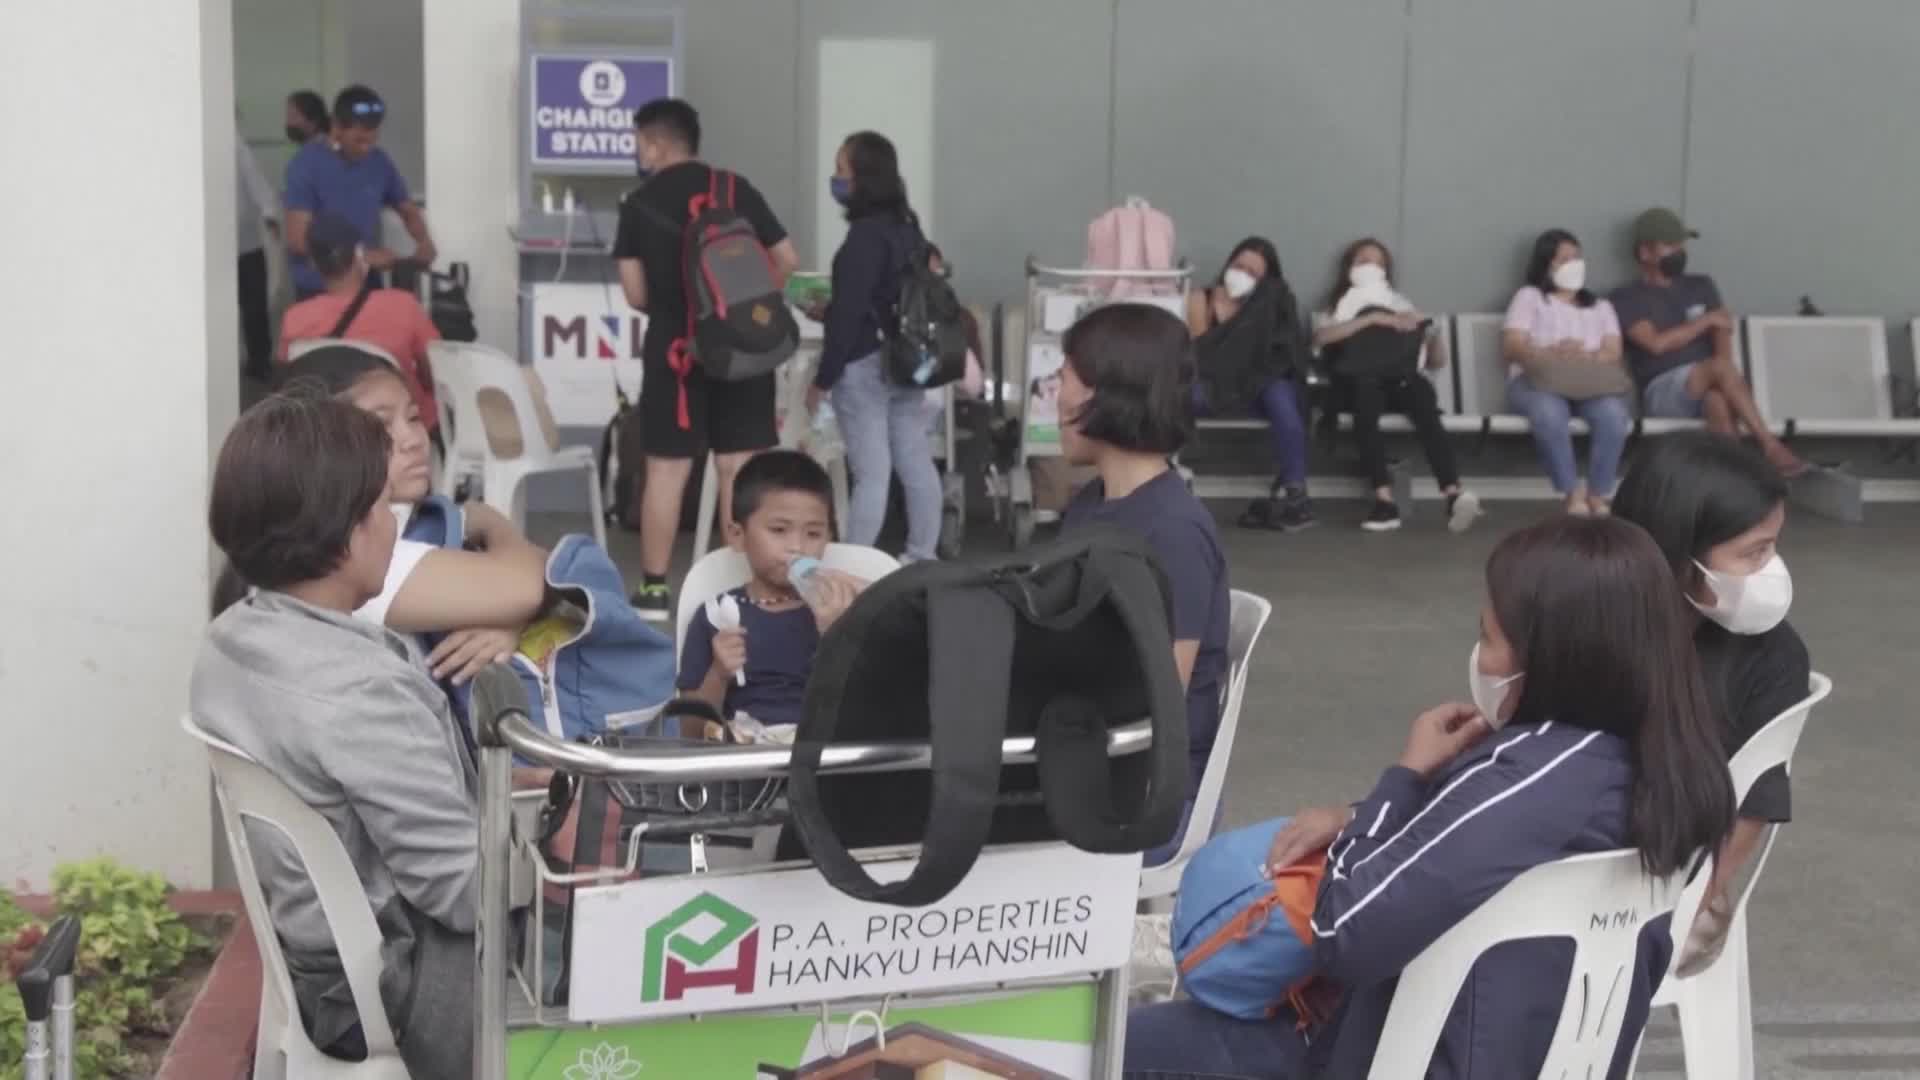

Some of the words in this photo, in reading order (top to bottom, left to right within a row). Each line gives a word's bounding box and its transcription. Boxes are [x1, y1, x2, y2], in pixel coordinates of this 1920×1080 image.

[537, 107, 635, 129] CHARGI
[552, 131, 638, 154] STATIO
[772, 920, 846, 952] P.A.
[866, 895, 1092, 944] PROPERTIES
[768, 946, 920, 988] HANKYU
[932, 929, 1088, 972] HANSHIN
